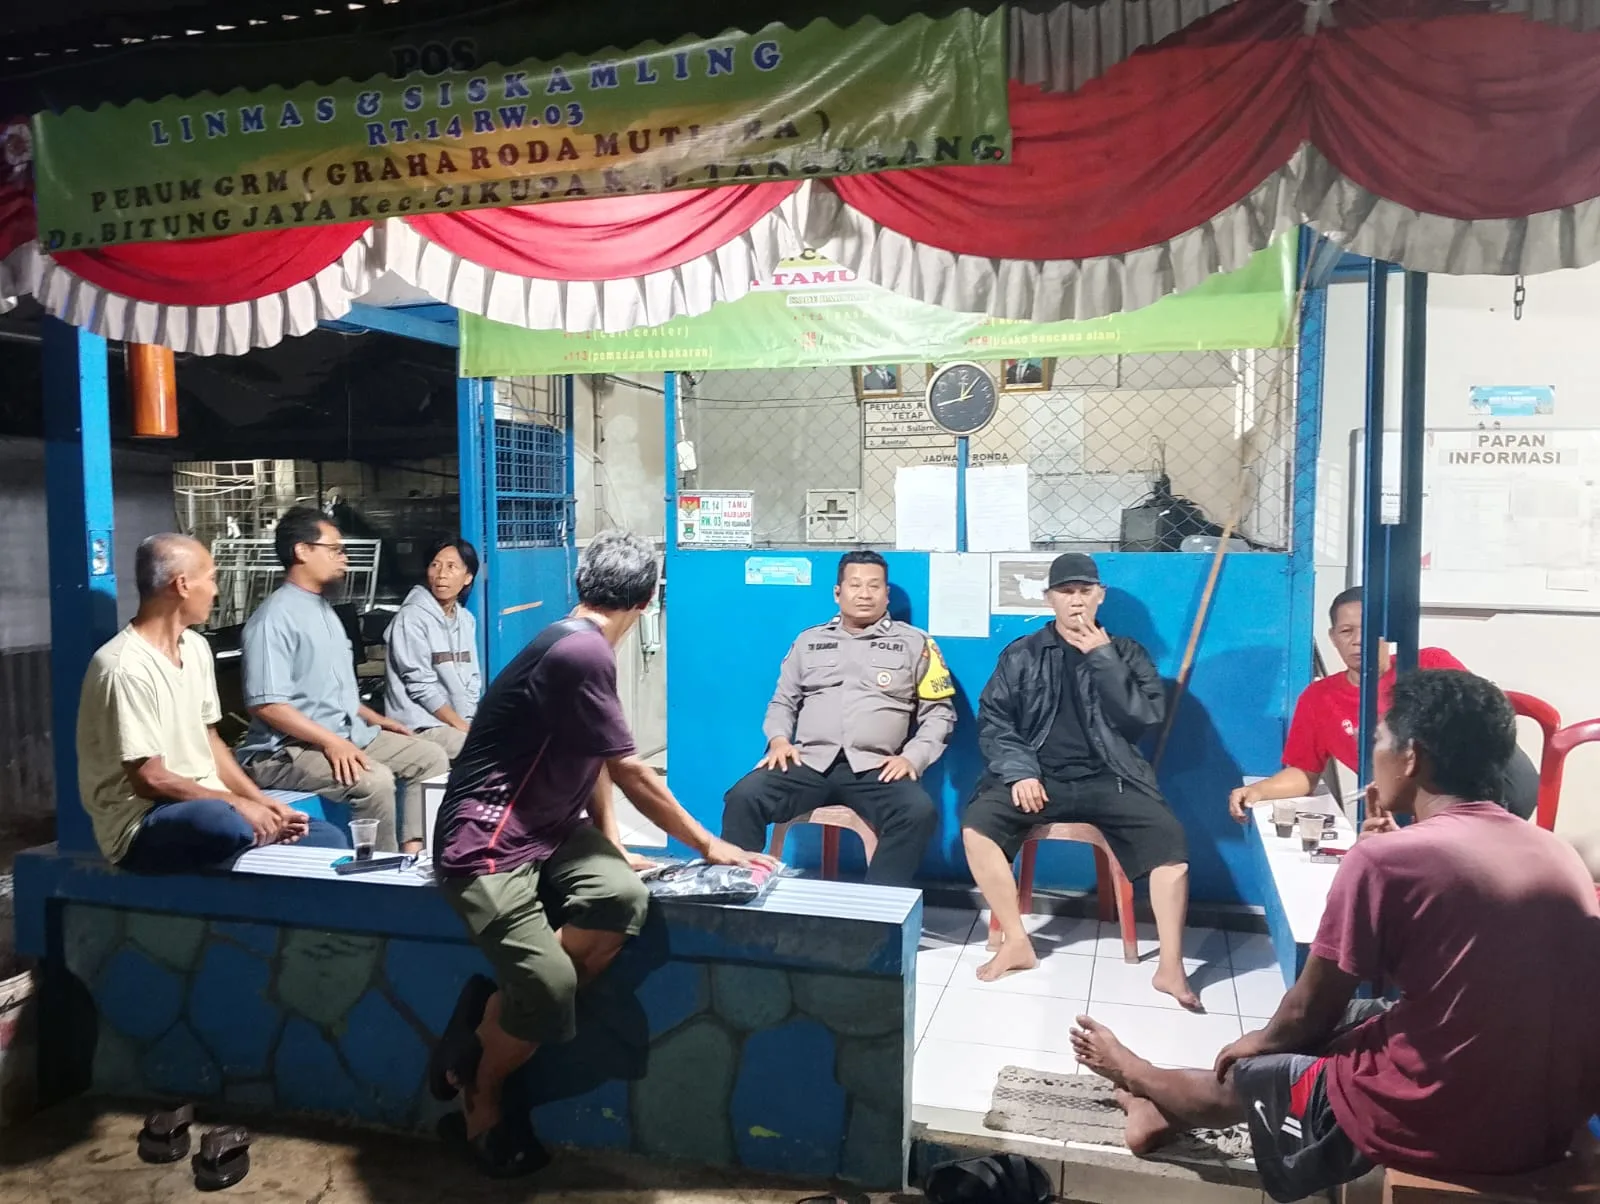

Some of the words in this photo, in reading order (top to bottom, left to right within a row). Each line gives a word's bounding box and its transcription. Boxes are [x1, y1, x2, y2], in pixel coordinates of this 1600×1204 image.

[389, 38, 476, 80] POS
[152, 95, 335, 145] LINMAS
[356, 90, 382, 117] &
[403, 41, 782, 111] SISKAMLING
[91, 178, 202, 213] PERUM
[215, 168, 288, 196] GRM
[470, 135, 579, 170] RODA
[243, 201, 336, 228] JAYA
[773, 270, 858, 285] TAMU
[869, 403, 912, 411] PETUGAS
[892, 412, 924, 420] TETAP
[1478, 434, 1546, 447] PAPAN
[923, 455, 958, 463] JADWA
[972, 453, 1009, 461] RONDA
[1448, 451, 1561, 464] INFORMASI
[870, 641, 904, 652] POLRI
